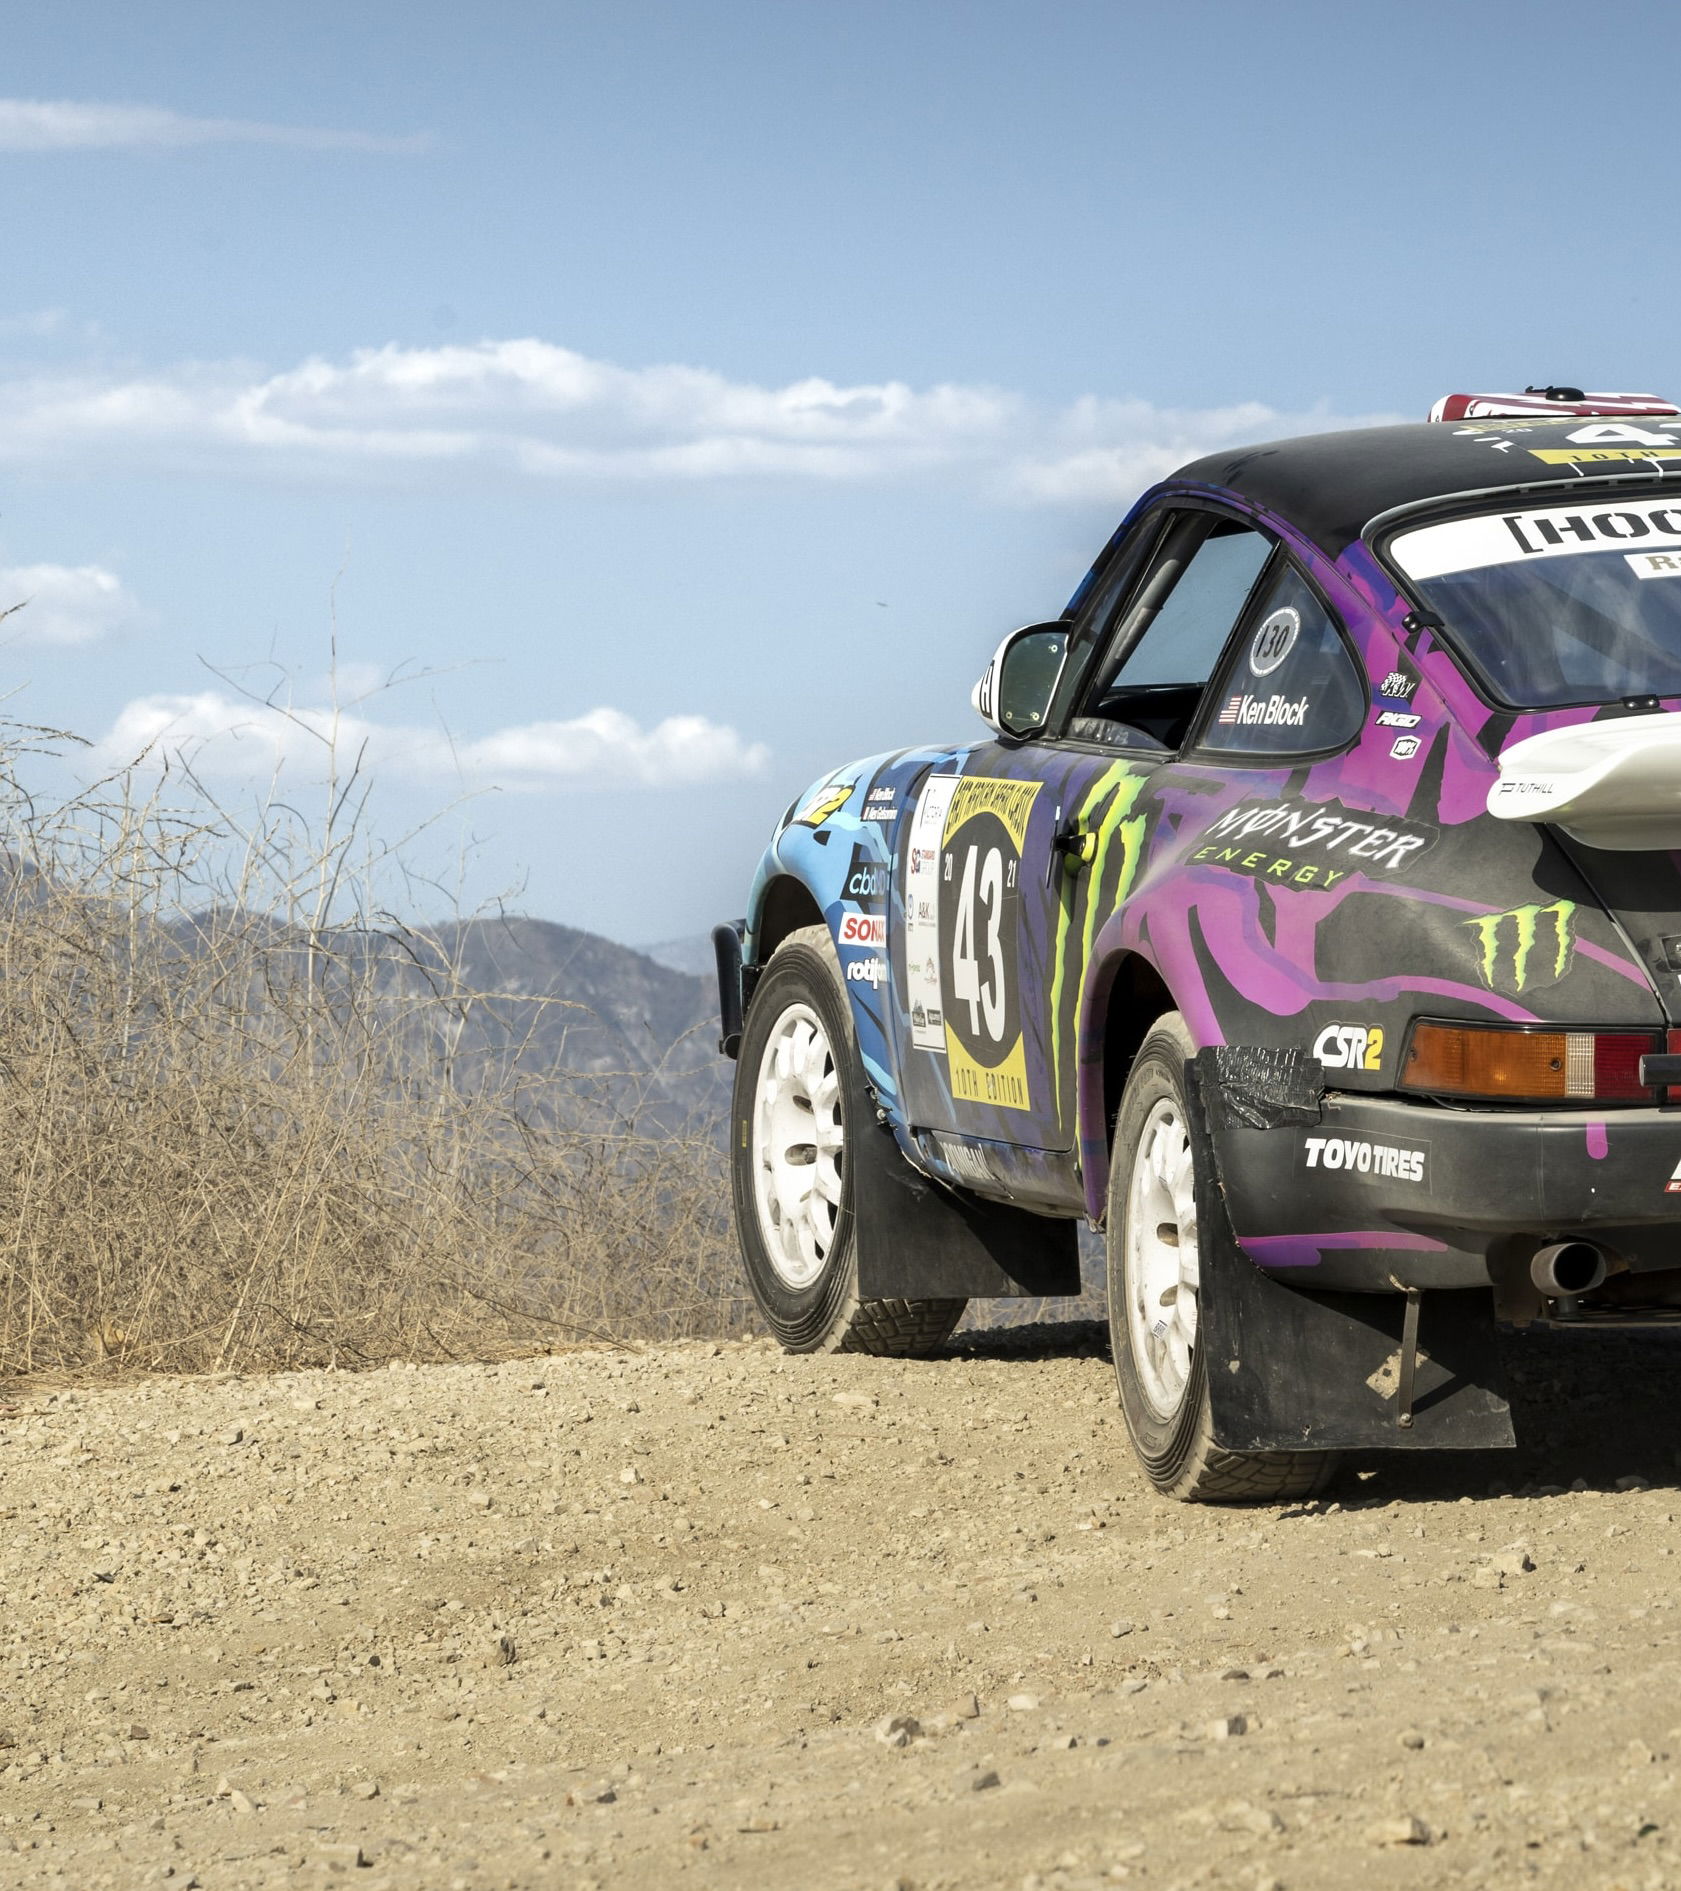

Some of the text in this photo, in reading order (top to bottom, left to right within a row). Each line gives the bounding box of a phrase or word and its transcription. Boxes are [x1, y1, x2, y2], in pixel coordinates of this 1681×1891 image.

[1570, 450, 1659, 462] 10TH
[1256, 624, 1290, 658] 130
[1237, 695, 1309, 726] Ken Block
[1516, 783, 1553, 794] TUTHILL
[944, 853, 953, 881] 20
[1007, 860, 1017, 888] 21
[1194, 846, 1344, 887] ENERGY
[952, 845, 1006, 1043] 43
[1313, 1024, 1383, 1071] CSR2
[956, 1068, 1024, 1105] 10TH EDITION
[1305, 1138, 1425, 1181] TOYO TIRES
